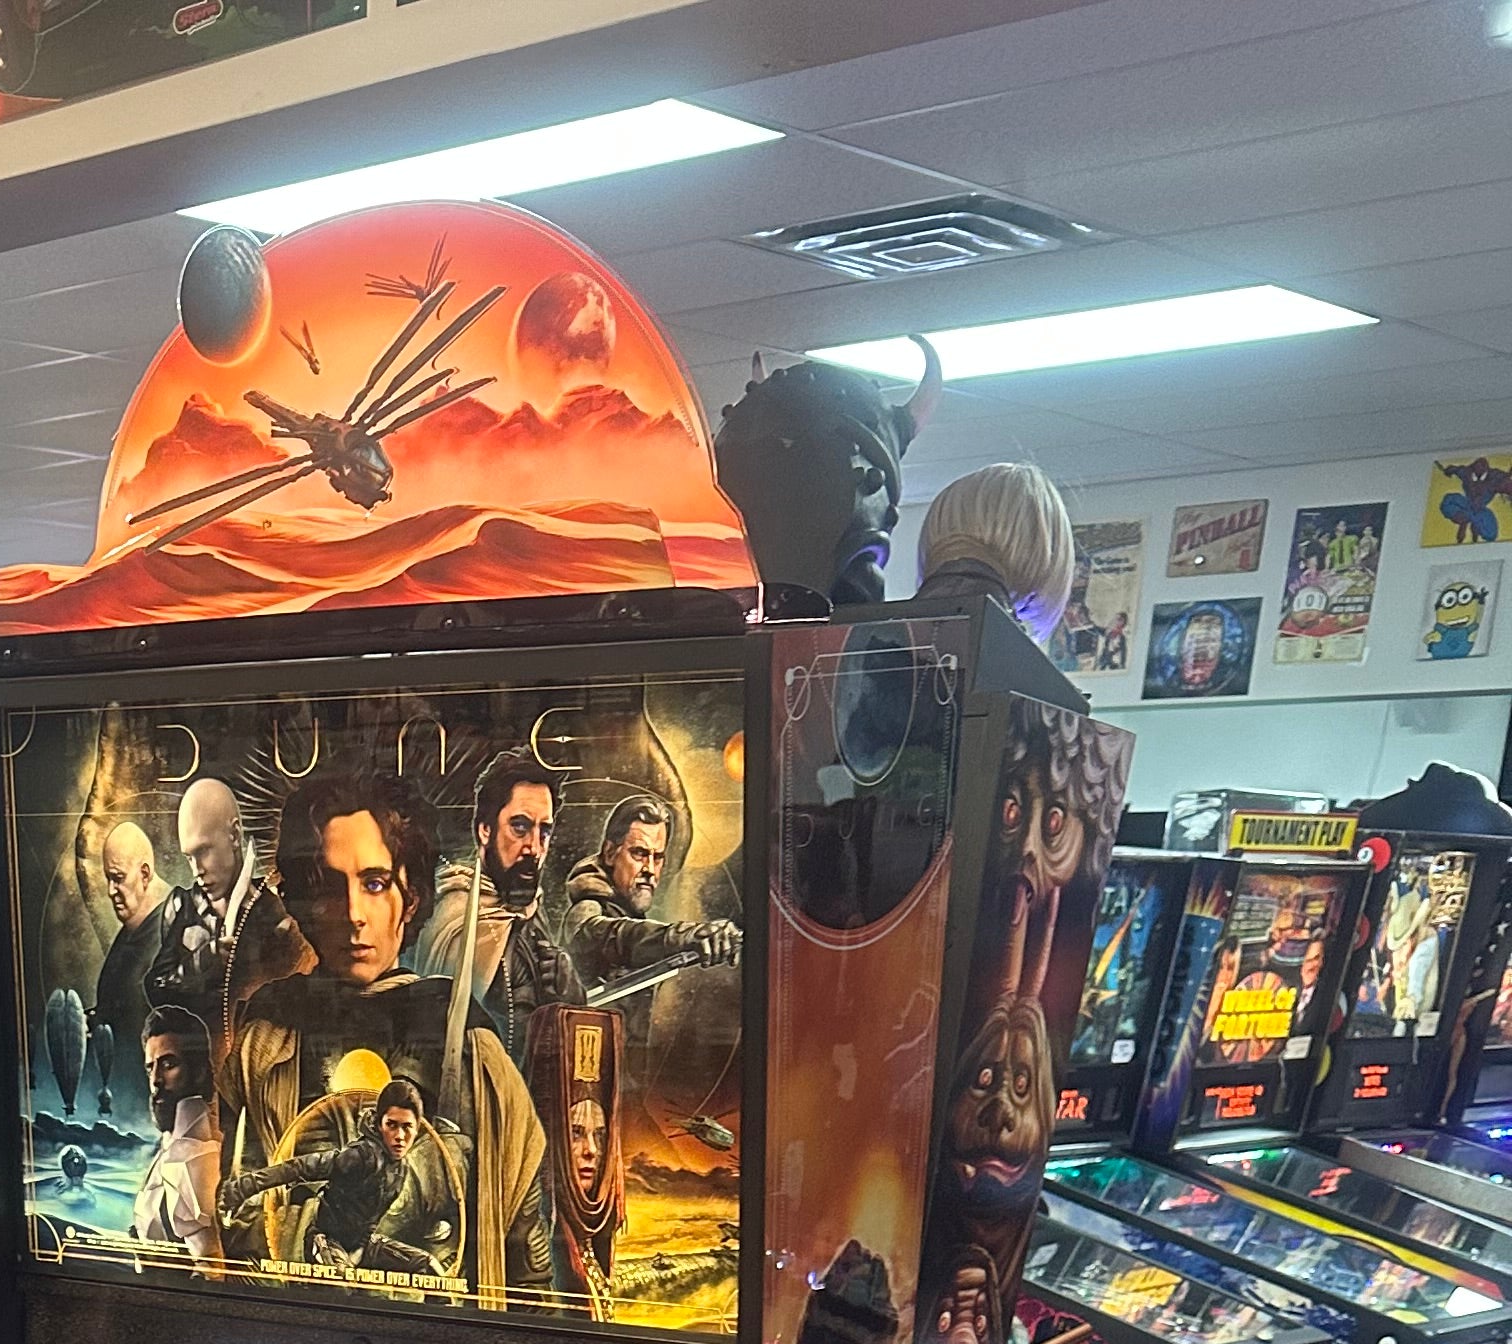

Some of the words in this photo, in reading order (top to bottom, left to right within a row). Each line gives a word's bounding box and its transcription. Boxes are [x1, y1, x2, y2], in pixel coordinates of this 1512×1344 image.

[1175, 503, 1262, 556] PINBALL
[157, 706, 584, 783] DUNE
[1239, 818, 1318, 846] TOURNAMENT
[1317, 820, 1349, 846] PLAY
[1222, 990, 1275, 1012] WHEEL
[1274, 987, 1298, 1010] OF
[1210, 1012, 1293, 1042] FORTUNE
[261, 1259, 287, 1274] POWER
[289, 1261, 311, 1276] OVER
[357, 1268, 385, 1284] POWER
[387, 1271, 410, 1286] OVER
